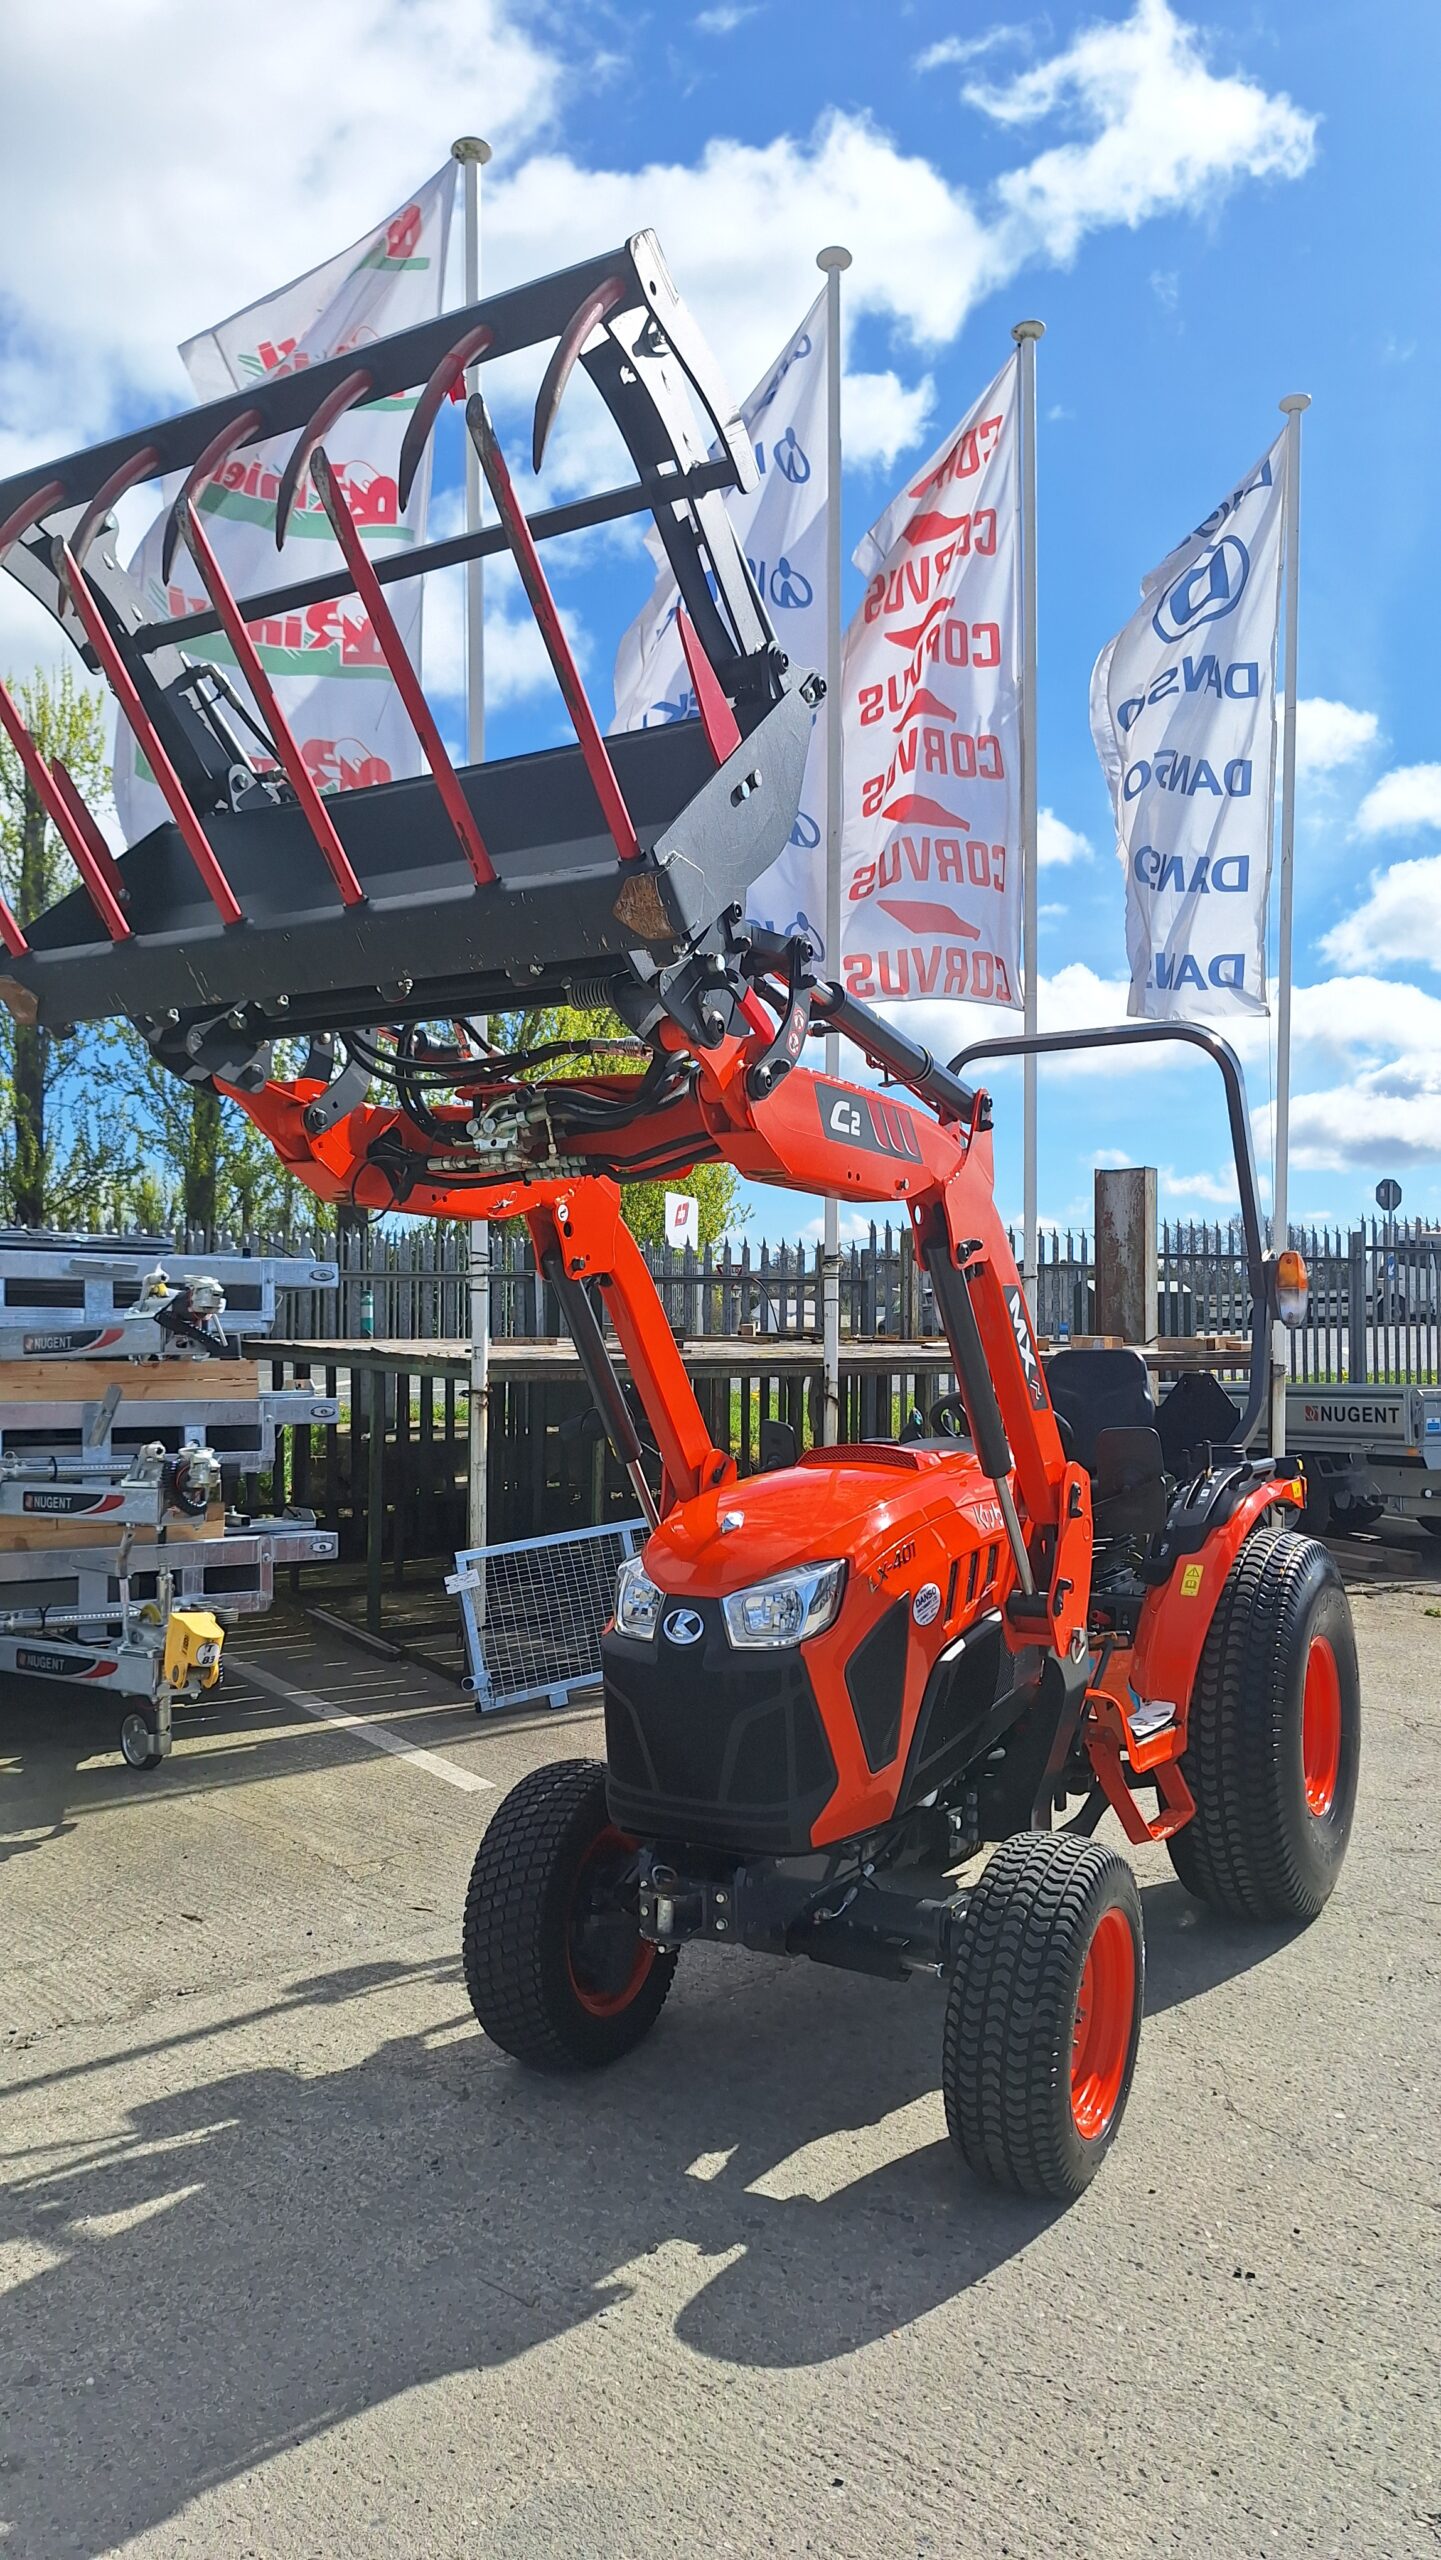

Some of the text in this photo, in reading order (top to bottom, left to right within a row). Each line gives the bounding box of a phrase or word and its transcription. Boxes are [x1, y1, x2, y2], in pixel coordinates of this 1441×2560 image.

[830, 1100, 861, 1137] C2
[34, 1336, 72, 1350] NUGENT
[1009, 1291, 1037, 1379] MX
[1321, 1406, 1399, 1423] NUGENT
[33, 1496, 72, 1509] NUGENT
[915, 1586, 937, 1608] DANSO
[27, 1654, 65, 1671] NUGENT
